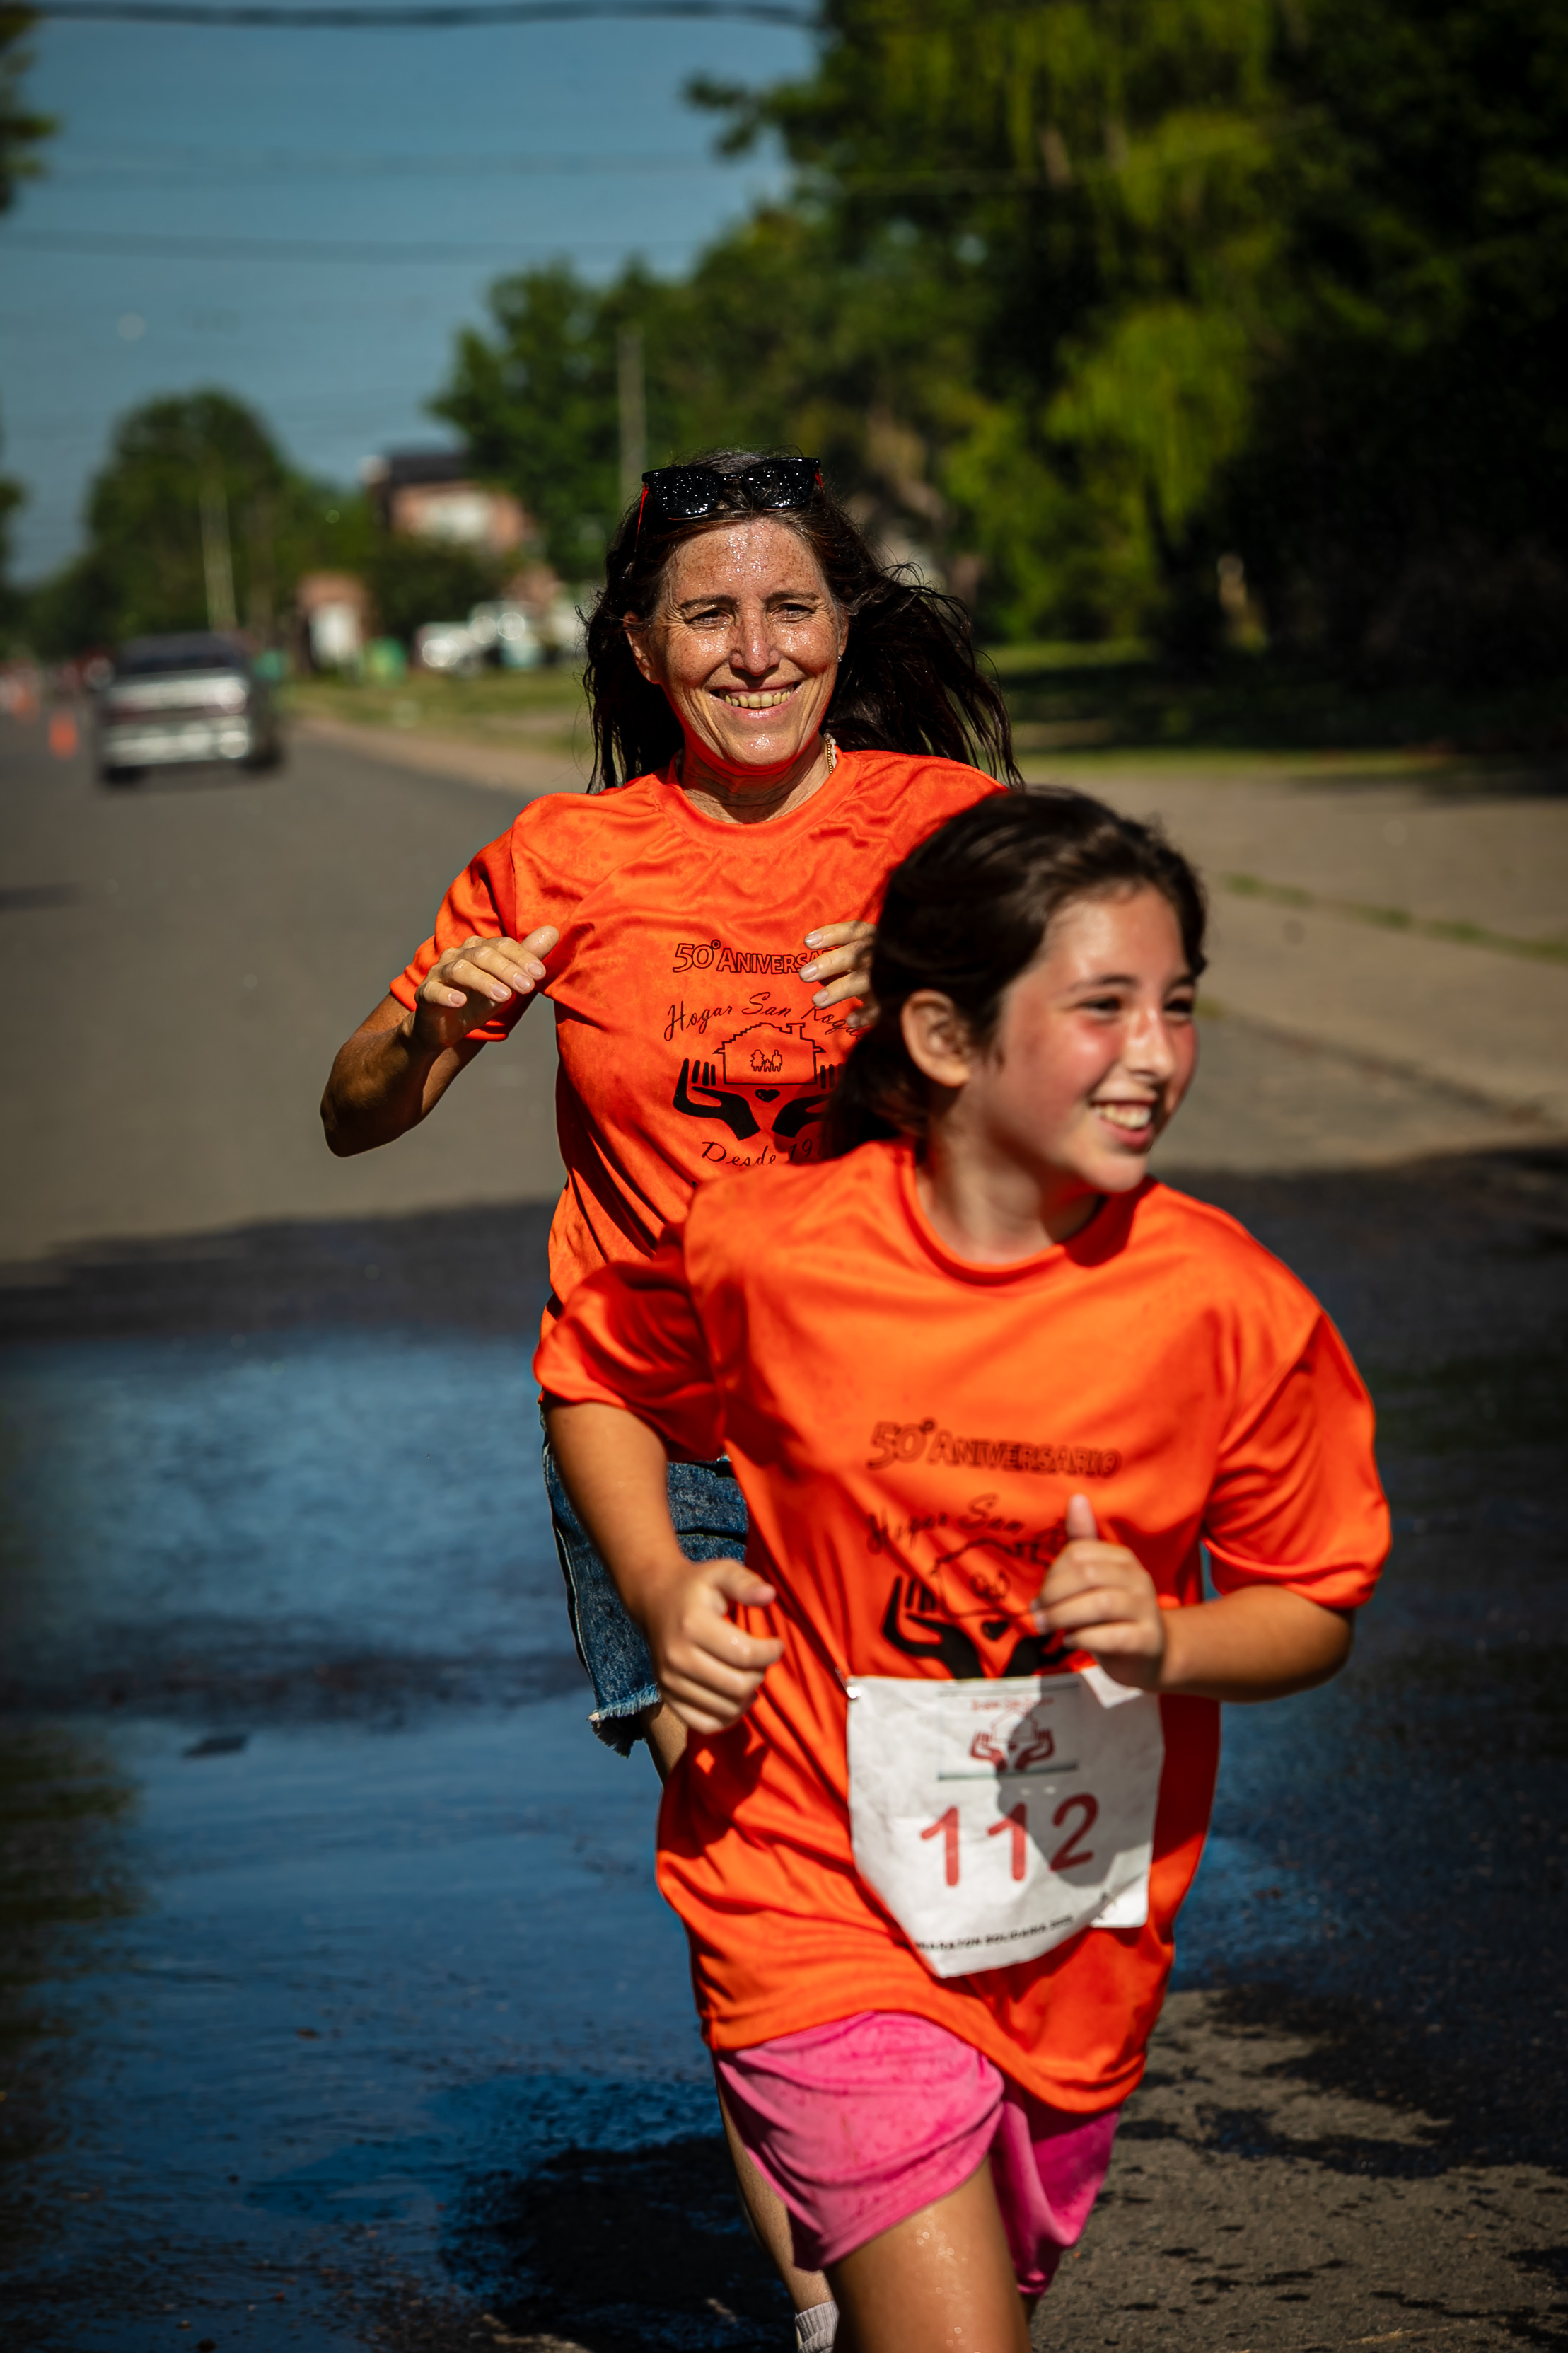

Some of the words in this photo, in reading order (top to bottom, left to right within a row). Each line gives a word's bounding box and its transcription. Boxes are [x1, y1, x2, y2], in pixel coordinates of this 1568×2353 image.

[664, 1000, 733, 1041] Hogar
[742, 991, 791, 1017] San
[701, 1141, 777, 1167] Desde
[926, 1428, 1123, 1480] ANIVERSARIO
[920, 1793, 1099, 1887] 112
